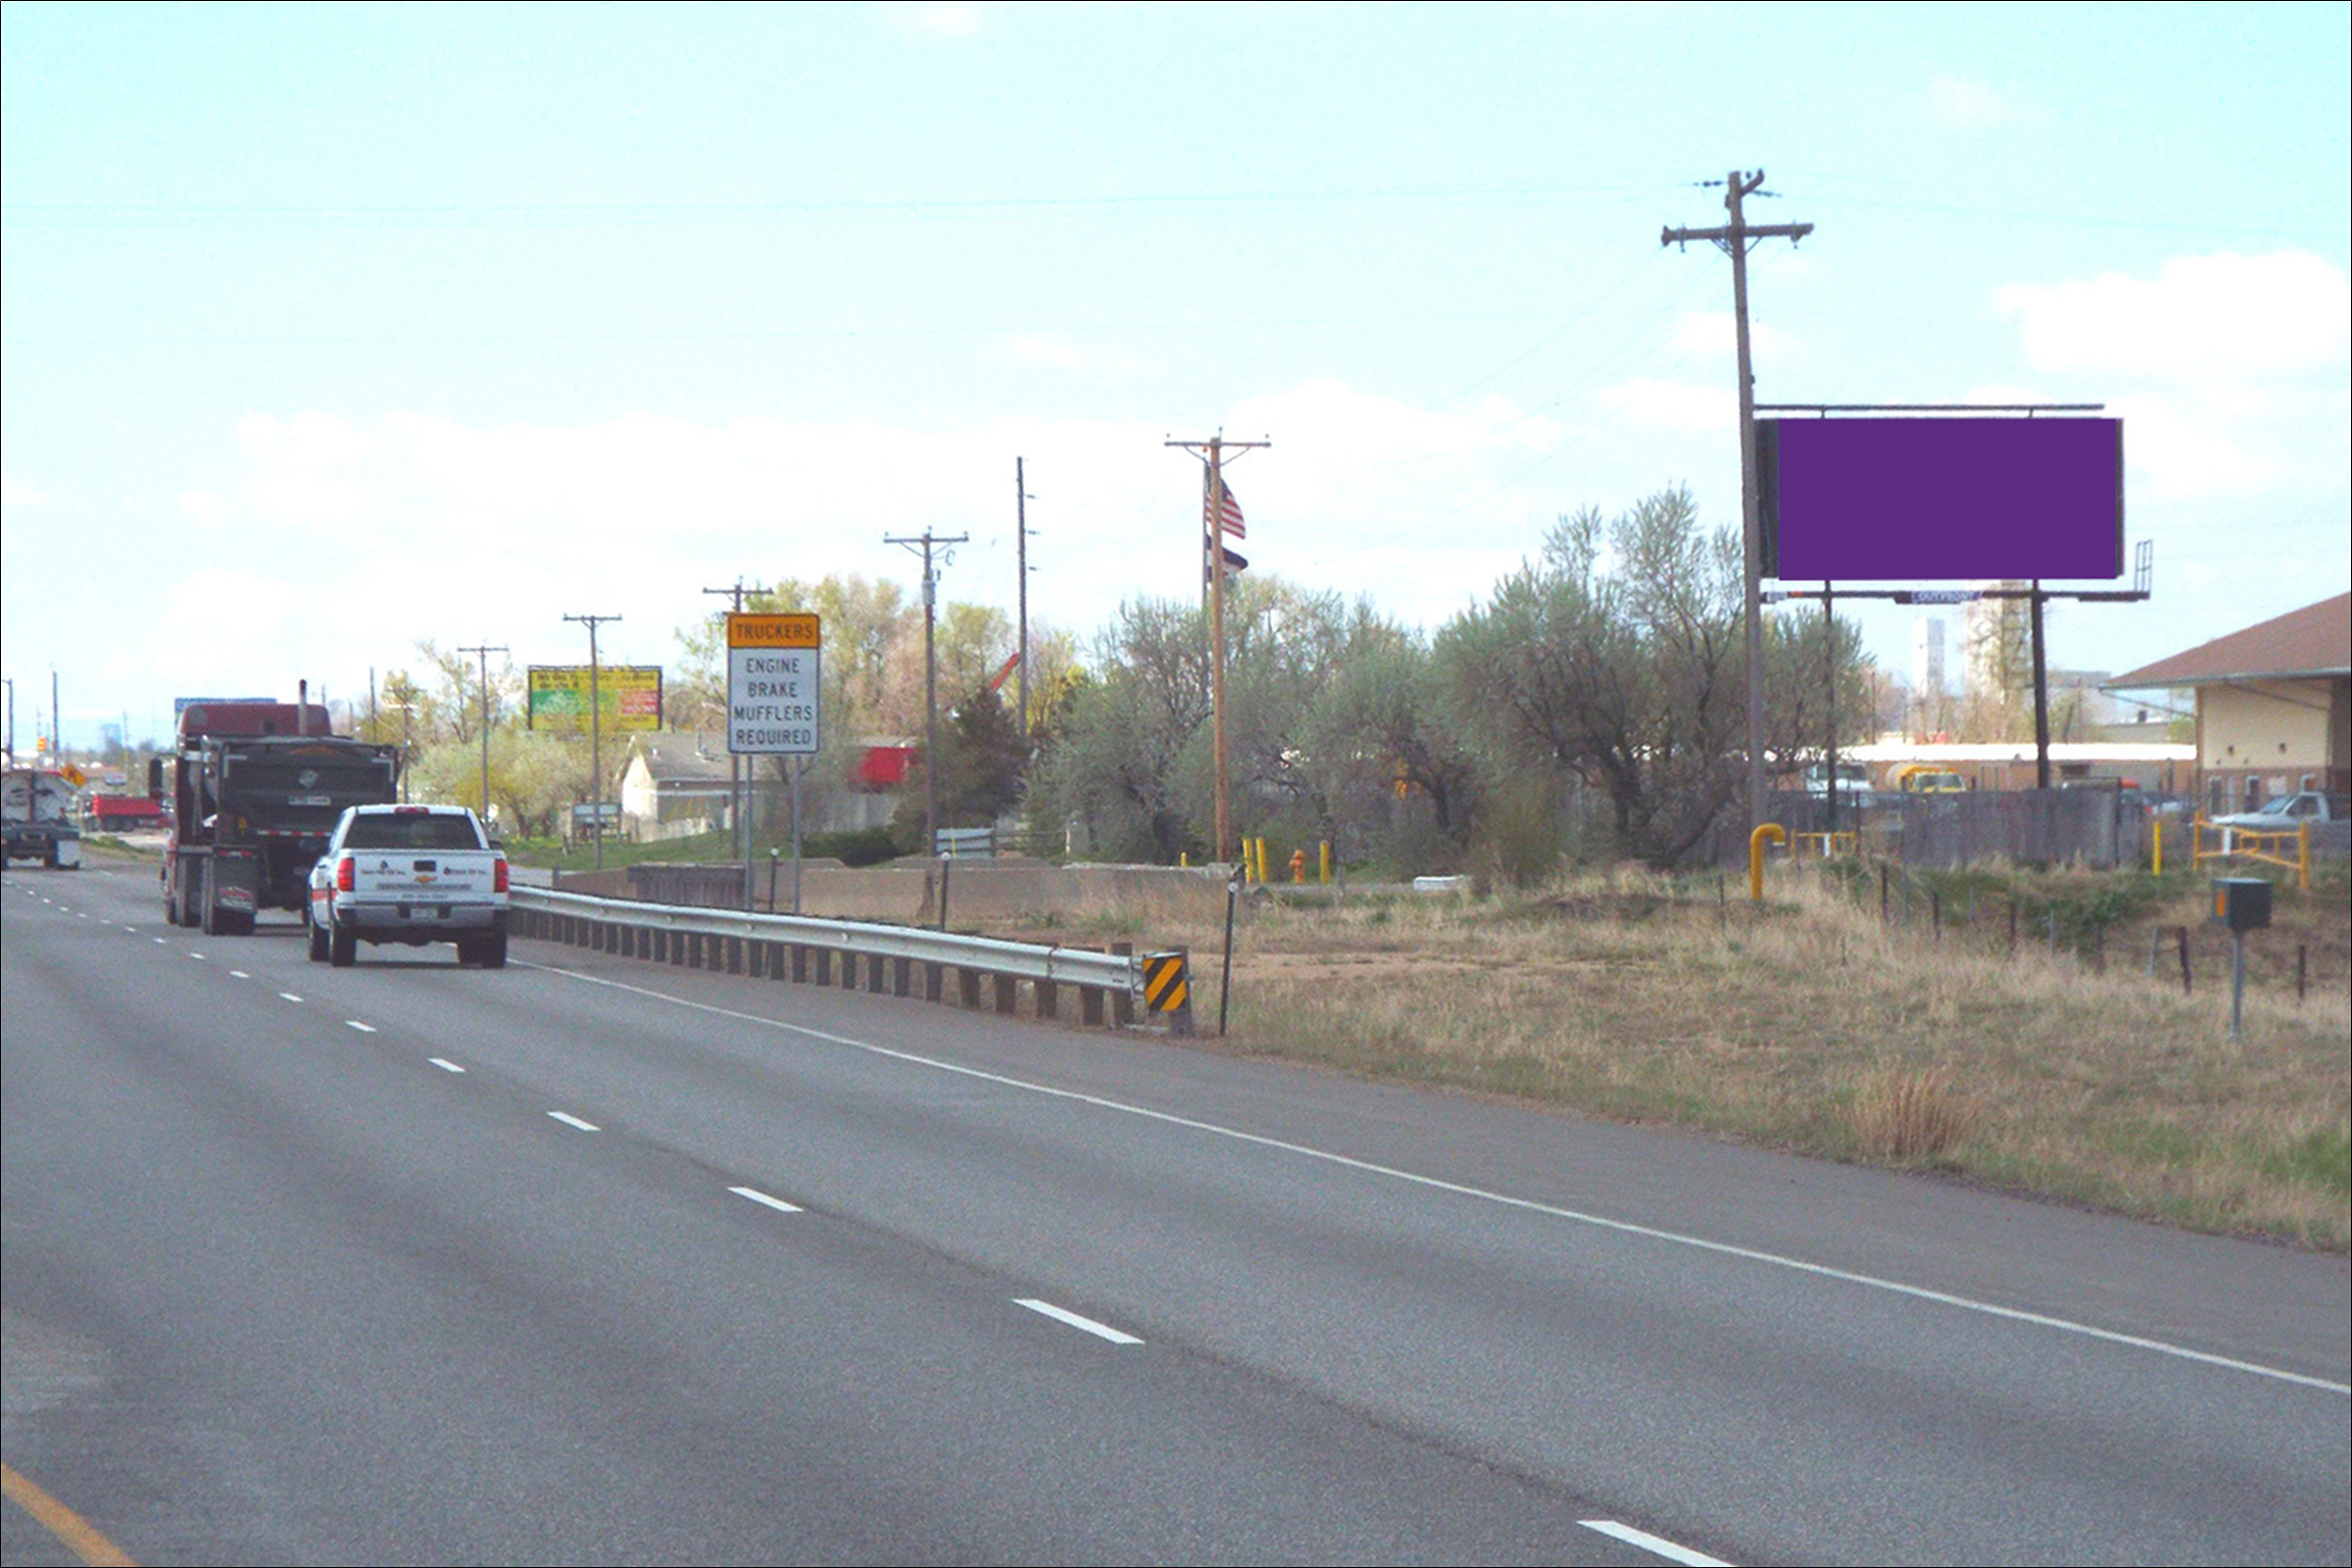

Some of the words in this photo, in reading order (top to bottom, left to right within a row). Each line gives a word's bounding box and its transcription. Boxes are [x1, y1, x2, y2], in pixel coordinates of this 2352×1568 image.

[735, 623, 813, 640] TRUCKERS
[746, 658, 800, 674] ENGINE
[748, 681, 798, 698] BRAKE
[734, 705, 812, 721] MUFFLERS
[736, 729, 811, 745] REQUIRED
